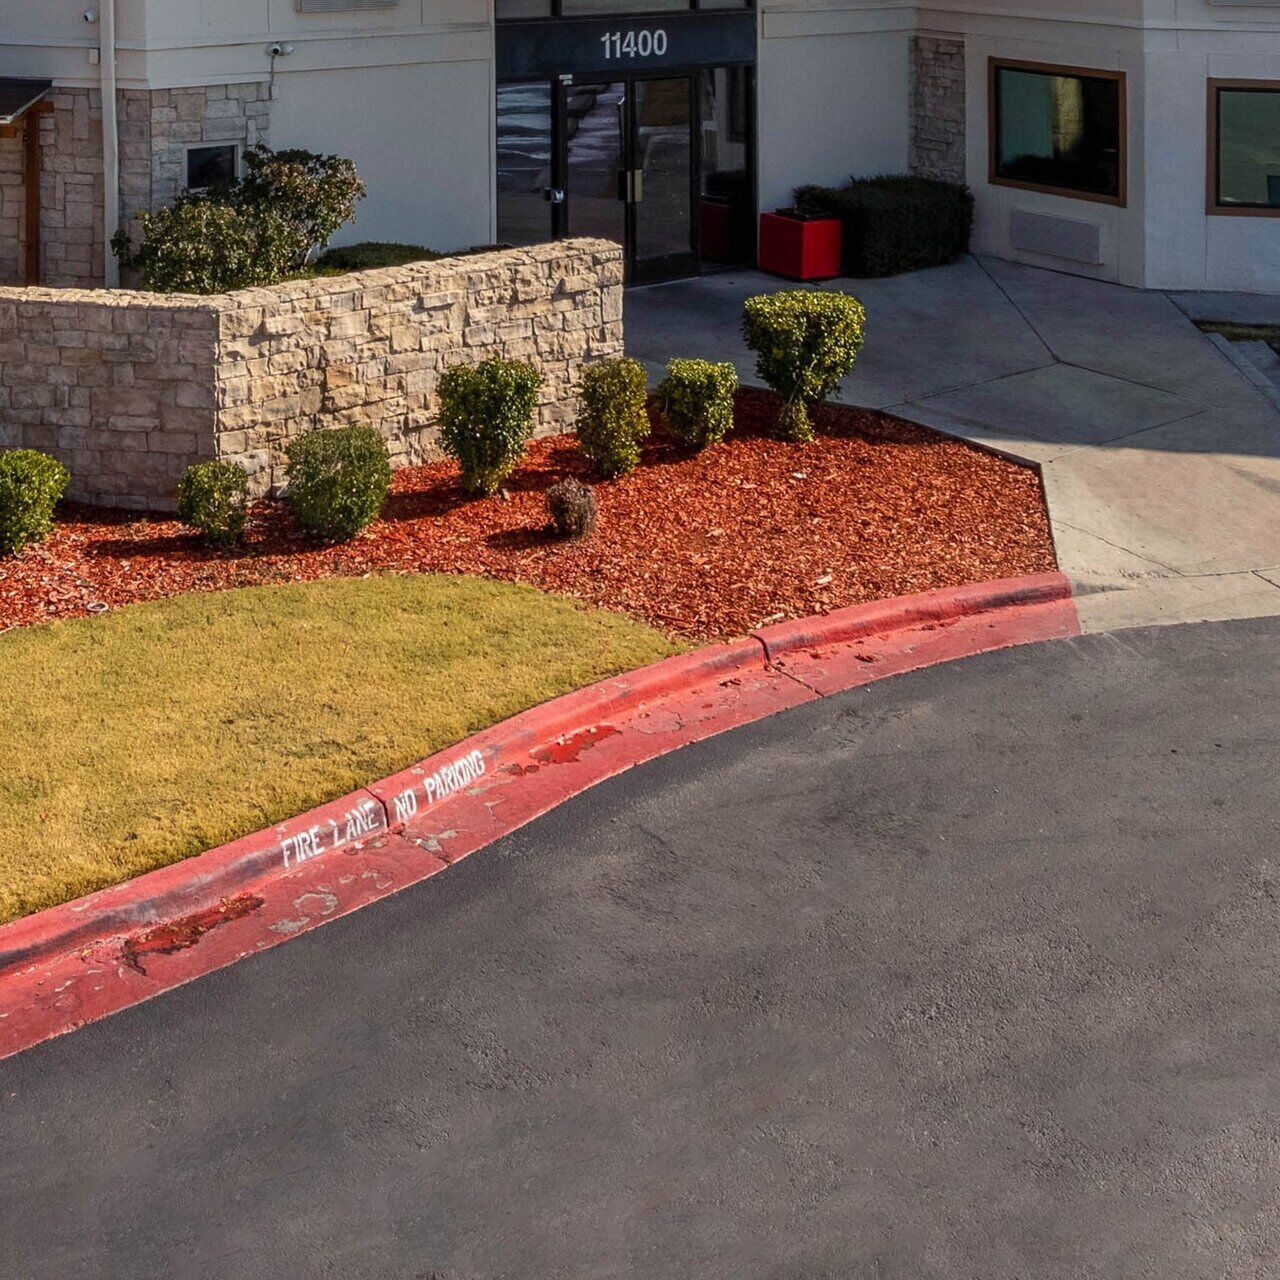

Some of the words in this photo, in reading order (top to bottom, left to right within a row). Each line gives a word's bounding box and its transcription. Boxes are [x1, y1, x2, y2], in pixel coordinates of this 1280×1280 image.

[600, 29, 668, 59] 11400
[280, 824, 326, 868] FIRE
[328, 800, 380, 848] LANE
[393, 788, 418, 822] NO
[423, 749, 486, 804] PARKING
